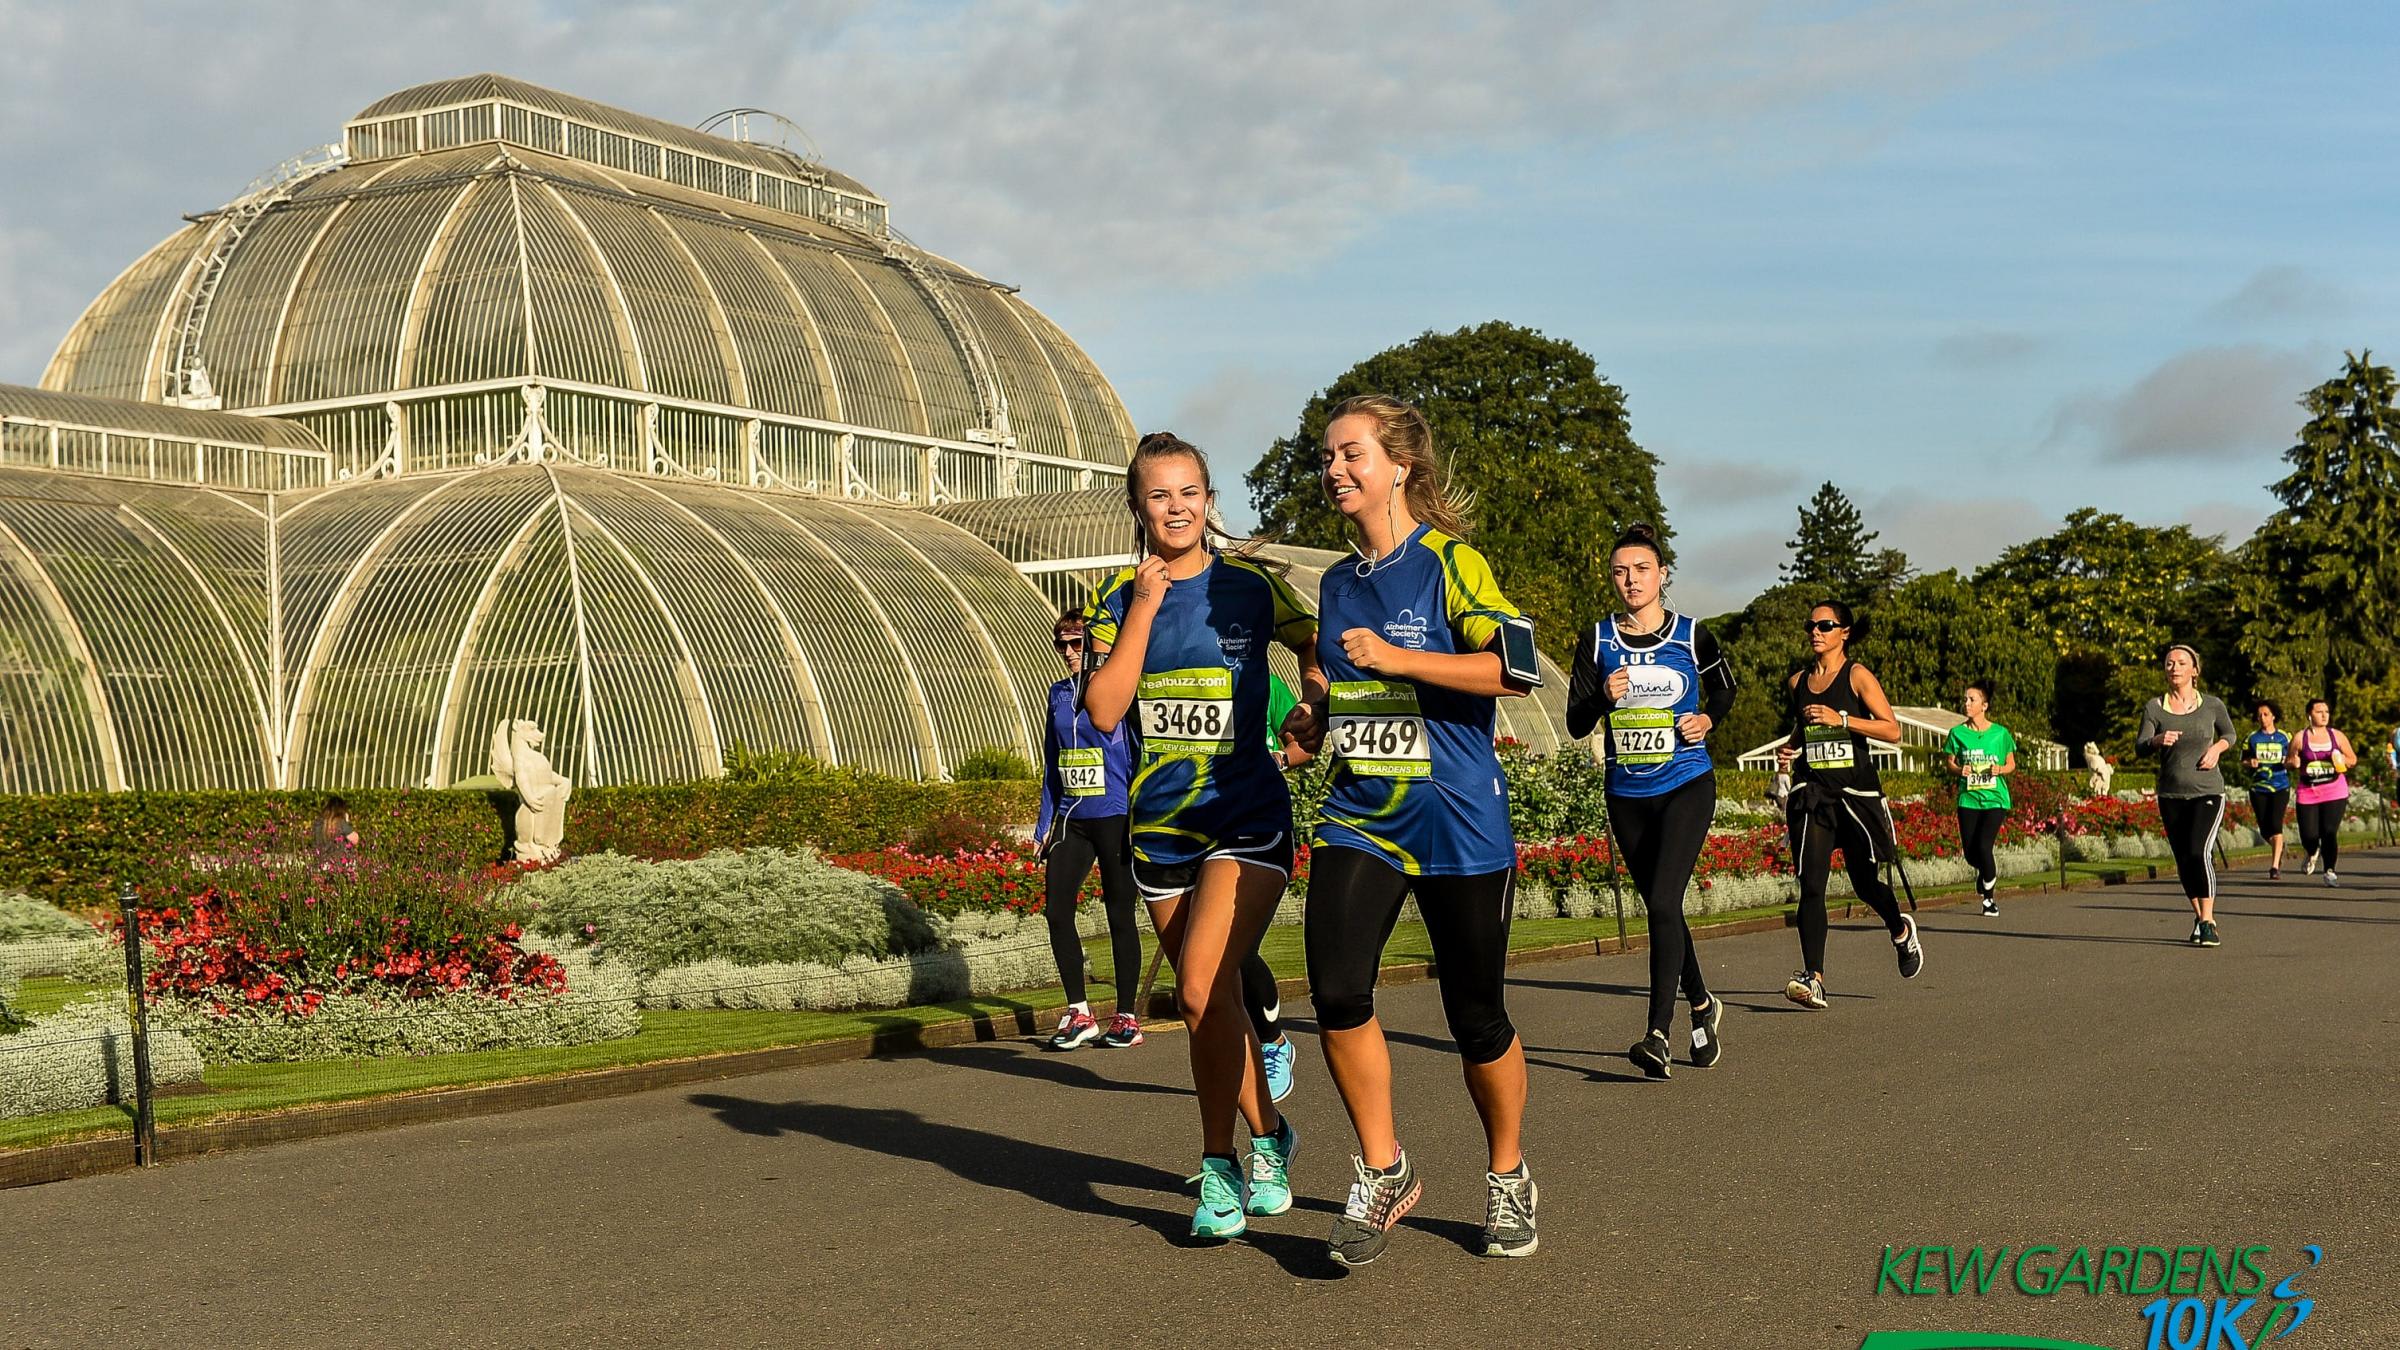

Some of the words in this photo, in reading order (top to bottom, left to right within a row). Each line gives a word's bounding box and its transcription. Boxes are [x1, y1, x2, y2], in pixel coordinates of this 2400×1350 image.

[1385, 623, 1428, 632] Alzheimer's
[1391, 630, 1419, 639] Society
[1143, 676, 1227, 689] realbuzz.com
[1629, 680, 1675, 693] mind
[1337, 688, 1417, 701] realbuzz.com
[1152, 702, 1221, 736] 3468
[1614, 712, 1669, 721] realbuzz.com
[1340, 719, 1418, 755] 3469
[1621, 730, 1665, 751] 4226
[1162, 743, 1179, 751] KEW
[1179, 744, 1217, 753] GARDENS
[1814, 742, 1846, 760] 1145
[1369, 766, 1411, 774] GARDENS
[1063, 768, 1097, 786] 1842
